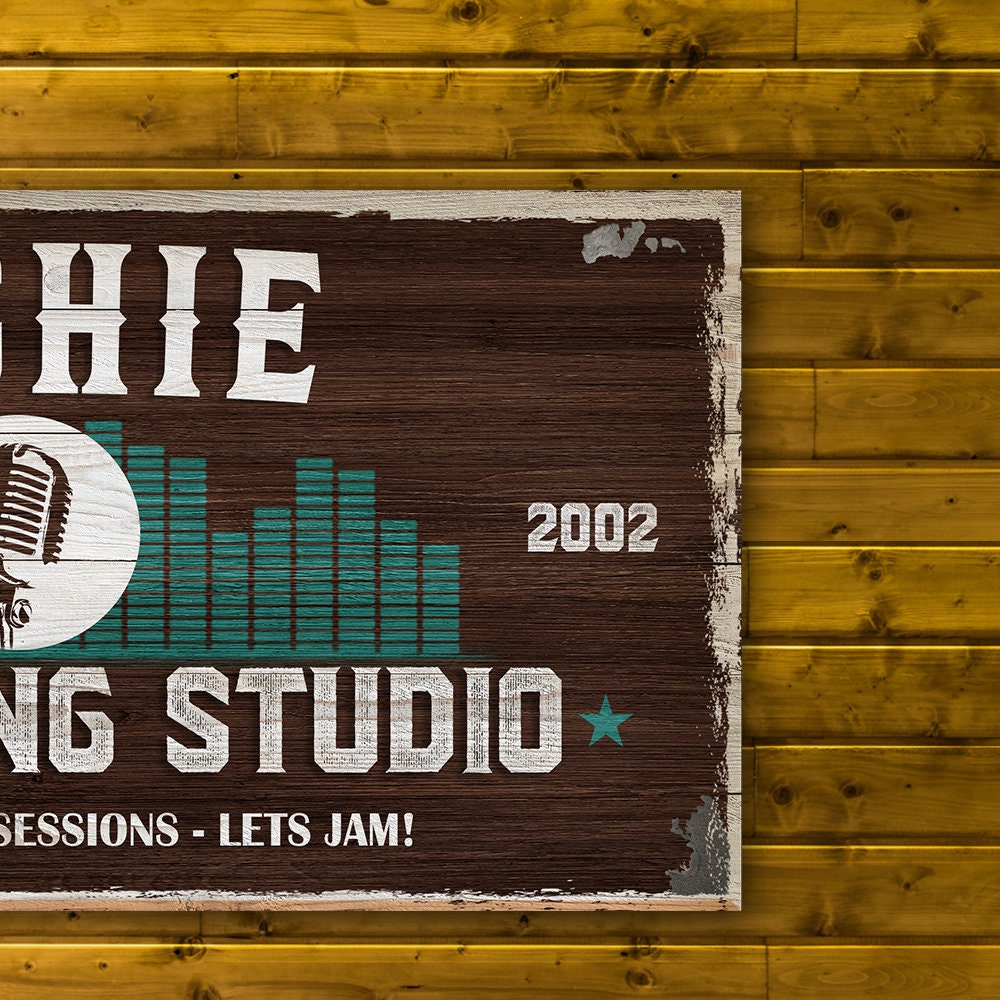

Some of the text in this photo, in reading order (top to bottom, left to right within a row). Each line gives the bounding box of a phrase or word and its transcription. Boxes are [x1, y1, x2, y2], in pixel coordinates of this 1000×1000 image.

[527, 502, 659, 553] 2002
[166, 666, 563, 775] STUDIO
[219, 812, 311, 847] LETS
[324, 812, 414, 849] JAM!
